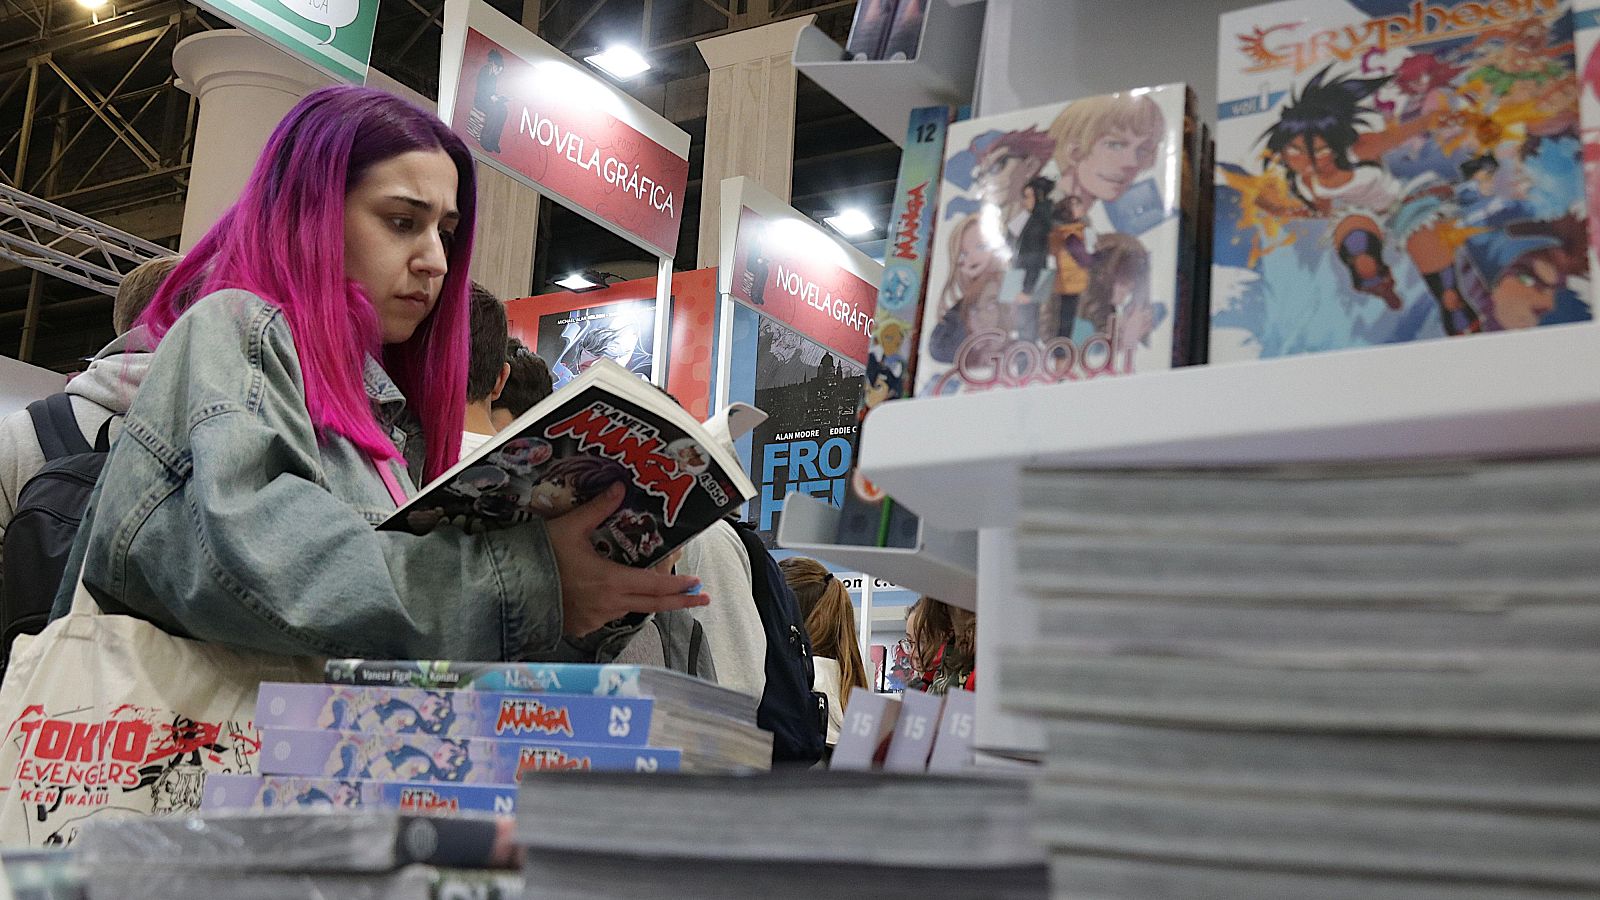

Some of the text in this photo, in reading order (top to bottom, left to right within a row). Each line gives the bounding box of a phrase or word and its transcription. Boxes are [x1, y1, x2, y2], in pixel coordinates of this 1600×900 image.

[916, 122, 937, 143] 12
[519, 106, 674, 218] NOVELA GRÁFICA
[776, 264, 876, 338] NOVELA GRÁFIC
[589, 401, 663, 441] PLANETA
[775, 432, 794, 441] ALAN
[794, 429, 820, 439] MOORE
[829, 427, 850, 435] EDDIE
[546, 406, 697, 528] MANGA
[762, 437, 853, 483] FRO
[363, 669, 391, 681] Vanesa
[496, 704, 573, 737] MANGA
[608, 704, 632, 737] 23
[851, 712, 873, 737] 15
[903, 715, 928, 740] 15
[949, 712, 973, 739] 15
[20, 718, 152, 763] TOKYO
[16, 759, 139, 785] EVENGERS
[634, 756, 658, 773] 2
[20, 790, 56, 803] KEN
[494, 795, 514, 813] 2
